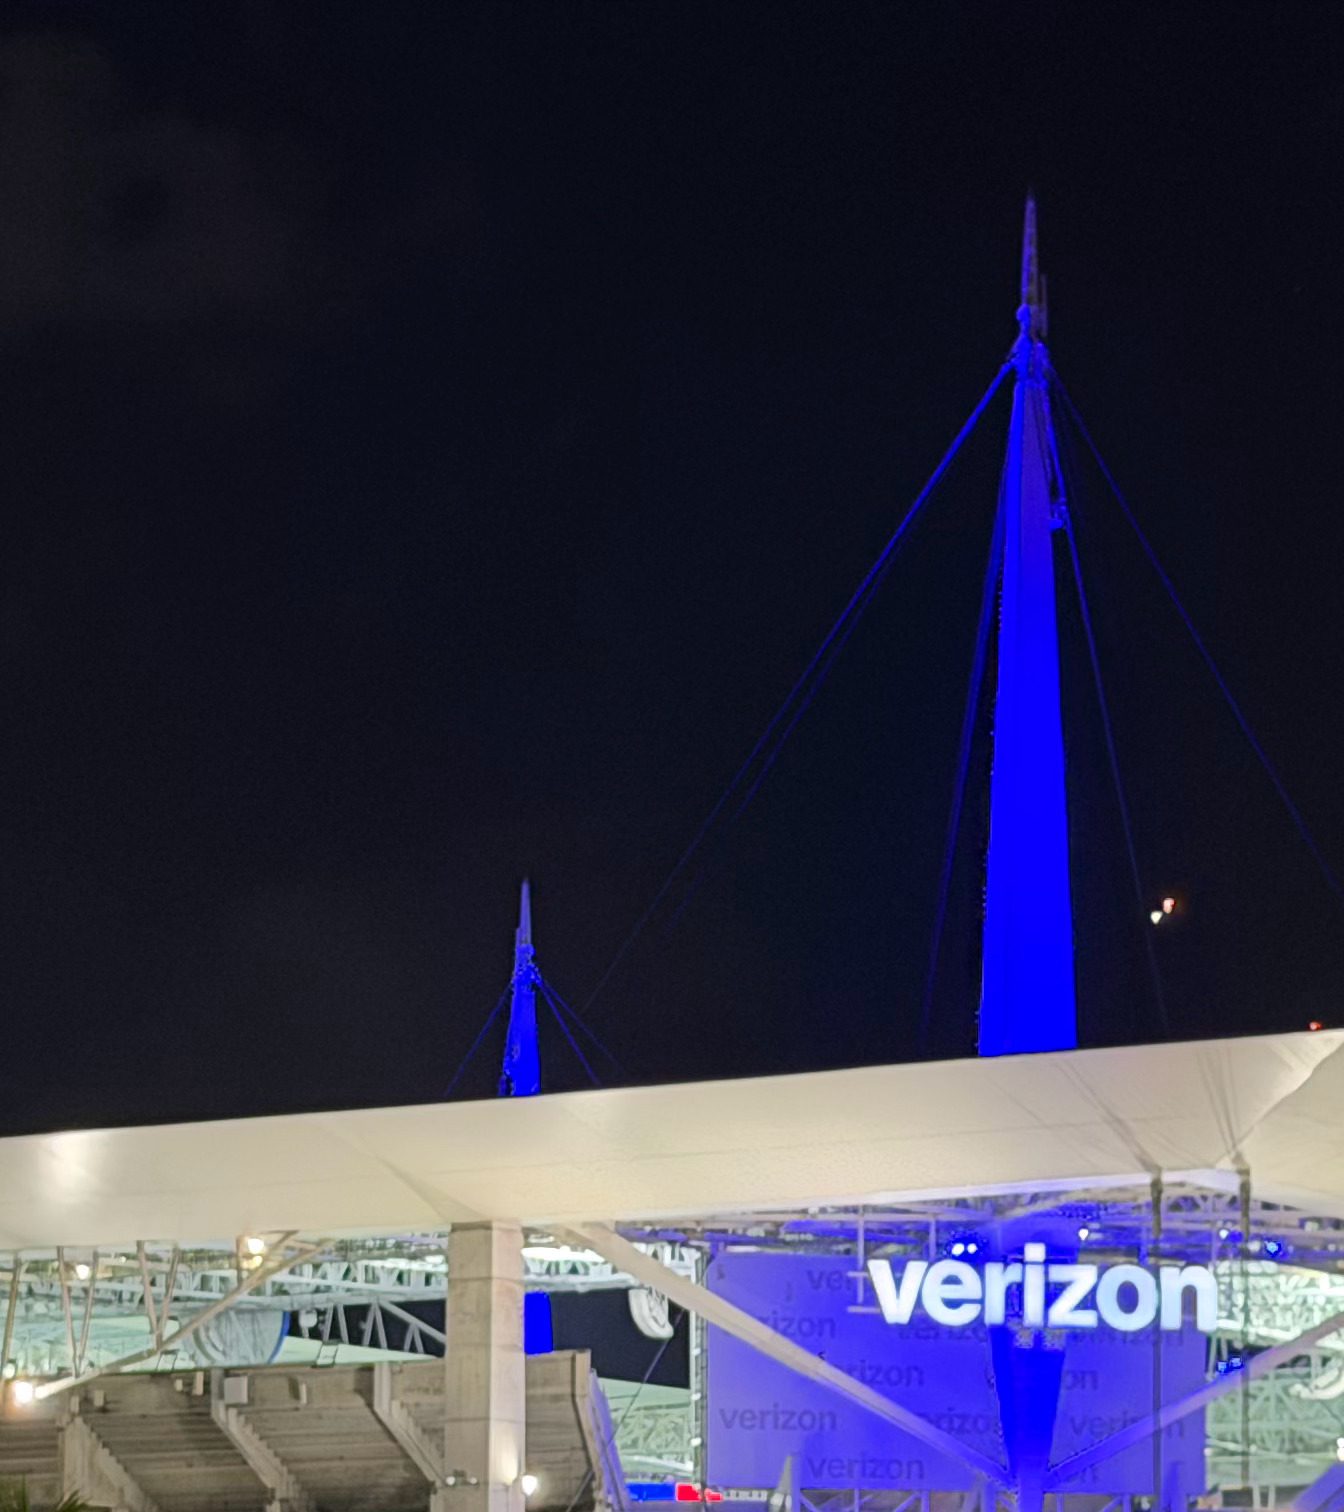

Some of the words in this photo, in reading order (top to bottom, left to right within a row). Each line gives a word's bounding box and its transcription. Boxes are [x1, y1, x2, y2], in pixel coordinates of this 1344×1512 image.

[867, 1242, 1218, 1332] verizon
[718, 1403, 838, 1432] verizon
[806, 1451, 926, 1482] verizon
